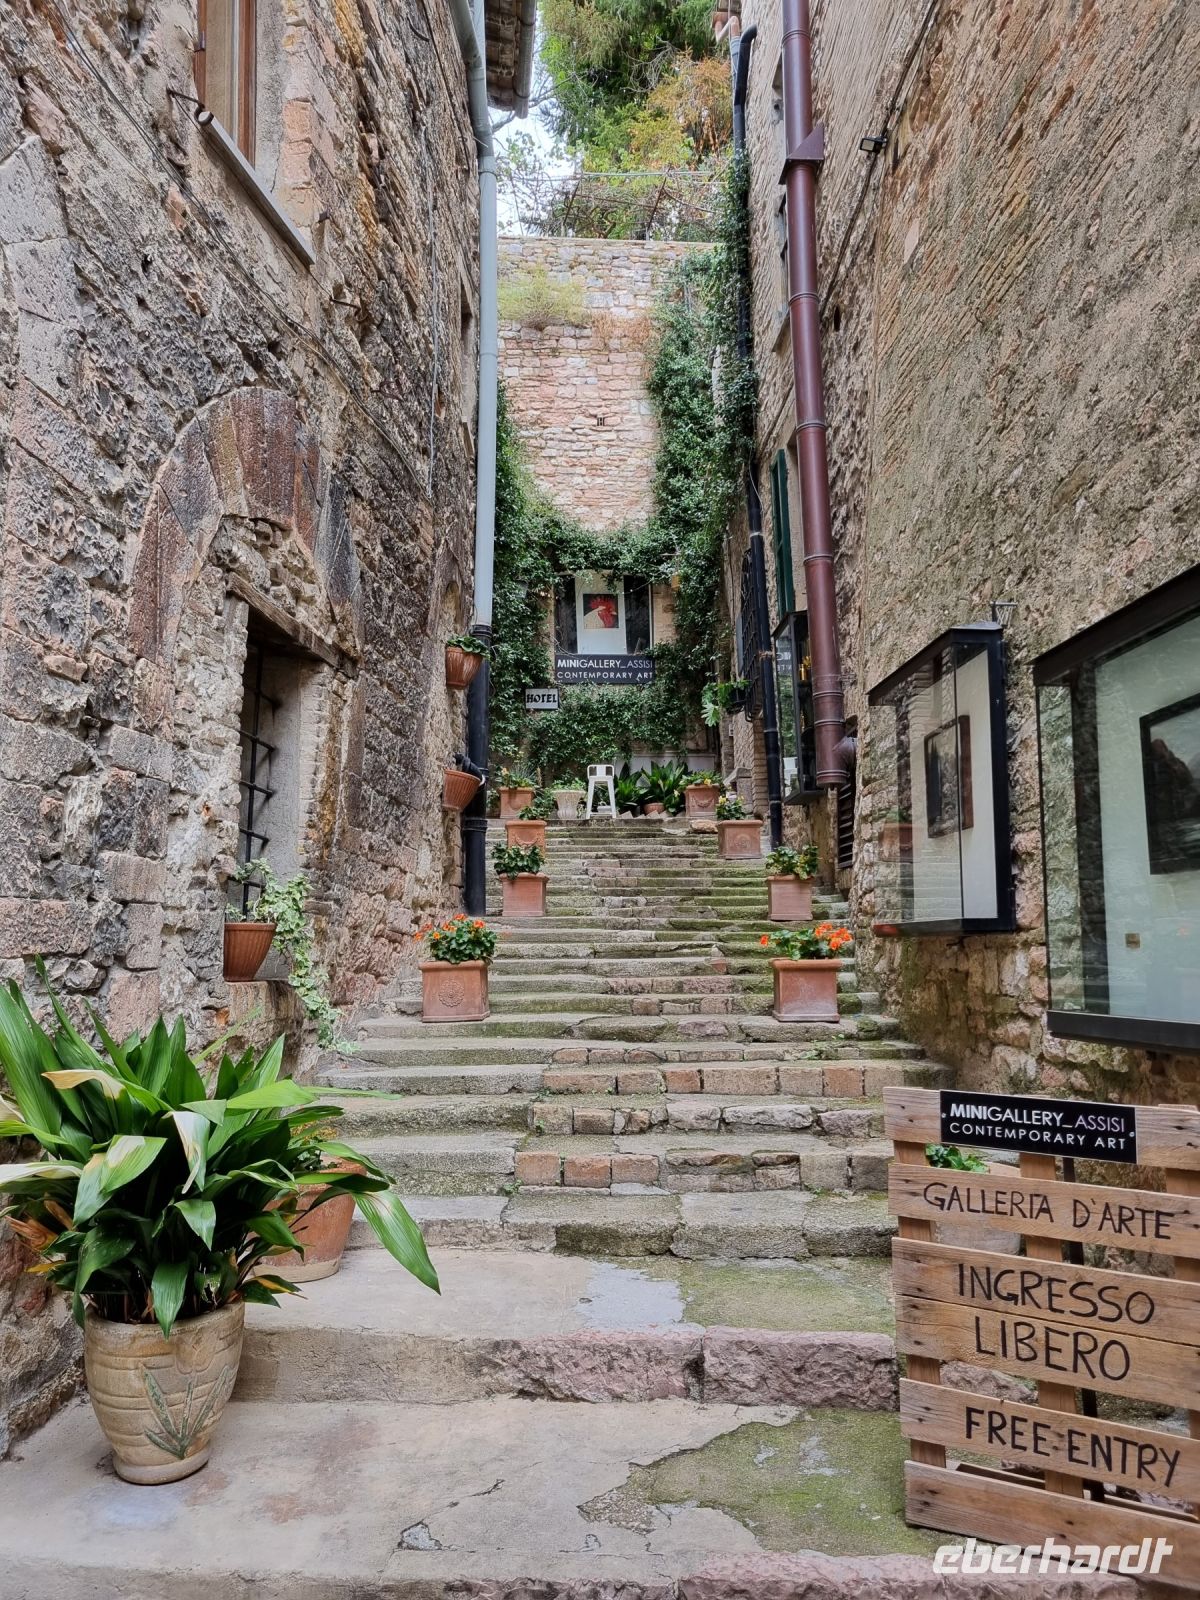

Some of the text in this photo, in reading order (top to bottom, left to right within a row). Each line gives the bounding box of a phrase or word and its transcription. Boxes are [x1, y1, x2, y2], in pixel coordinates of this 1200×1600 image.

[556, 671, 653, 679] CONTEMPORARY ART
[526, 693, 557, 703] HOTEL
[950, 1122, 1126, 1150] CONTEMPORARY ART
[923, 1182, 1176, 1240] GALLERIA D'ARTE
[958, 1263, 1155, 1325] INGRESSO
[975, 1316, 1130, 1381] LIBERO
